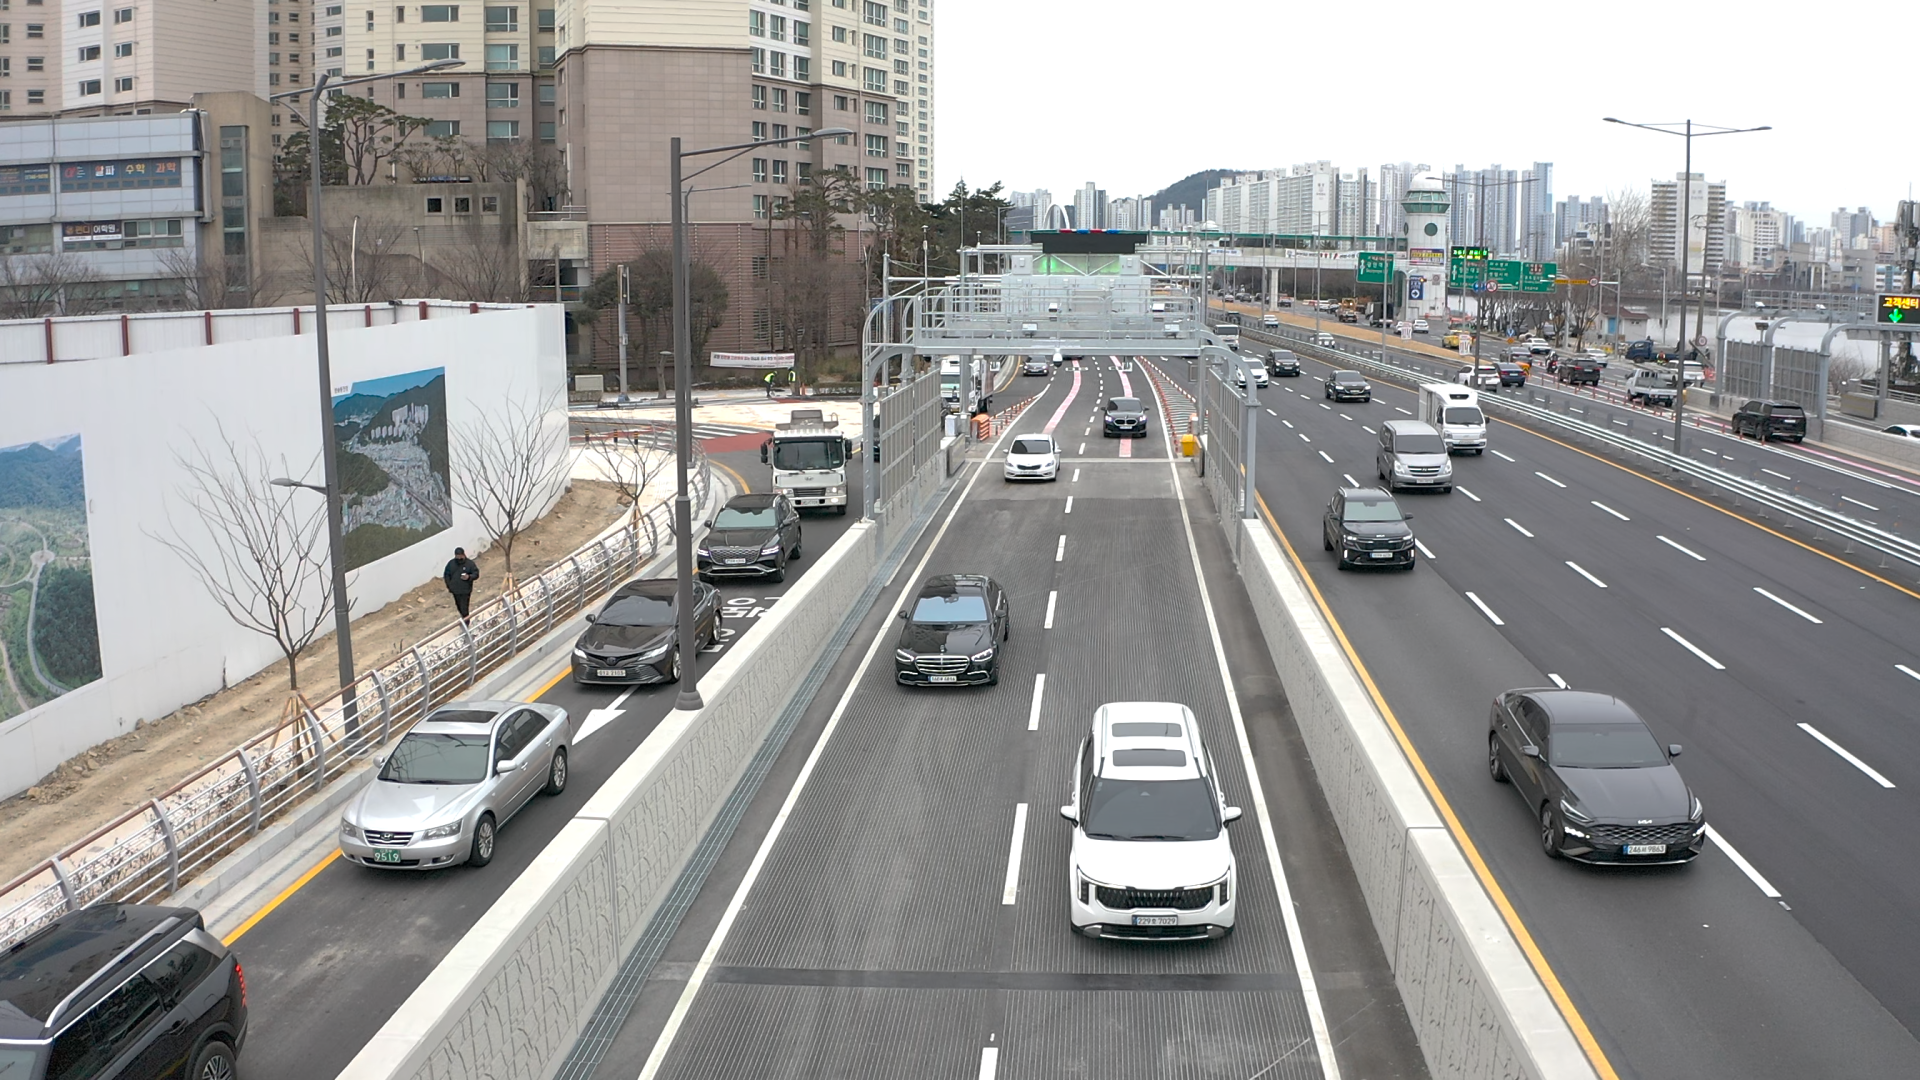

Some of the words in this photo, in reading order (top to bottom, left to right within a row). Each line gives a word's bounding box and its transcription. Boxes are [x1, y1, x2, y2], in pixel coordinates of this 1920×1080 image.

[94, 164, 115, 177] 알파
[125, 163, 146, 175] 수학
[155, 162, 177, 174] 과학
[1883, 297, 1919, 309] 고객센터
[374, 852, 399, 861] 9519
